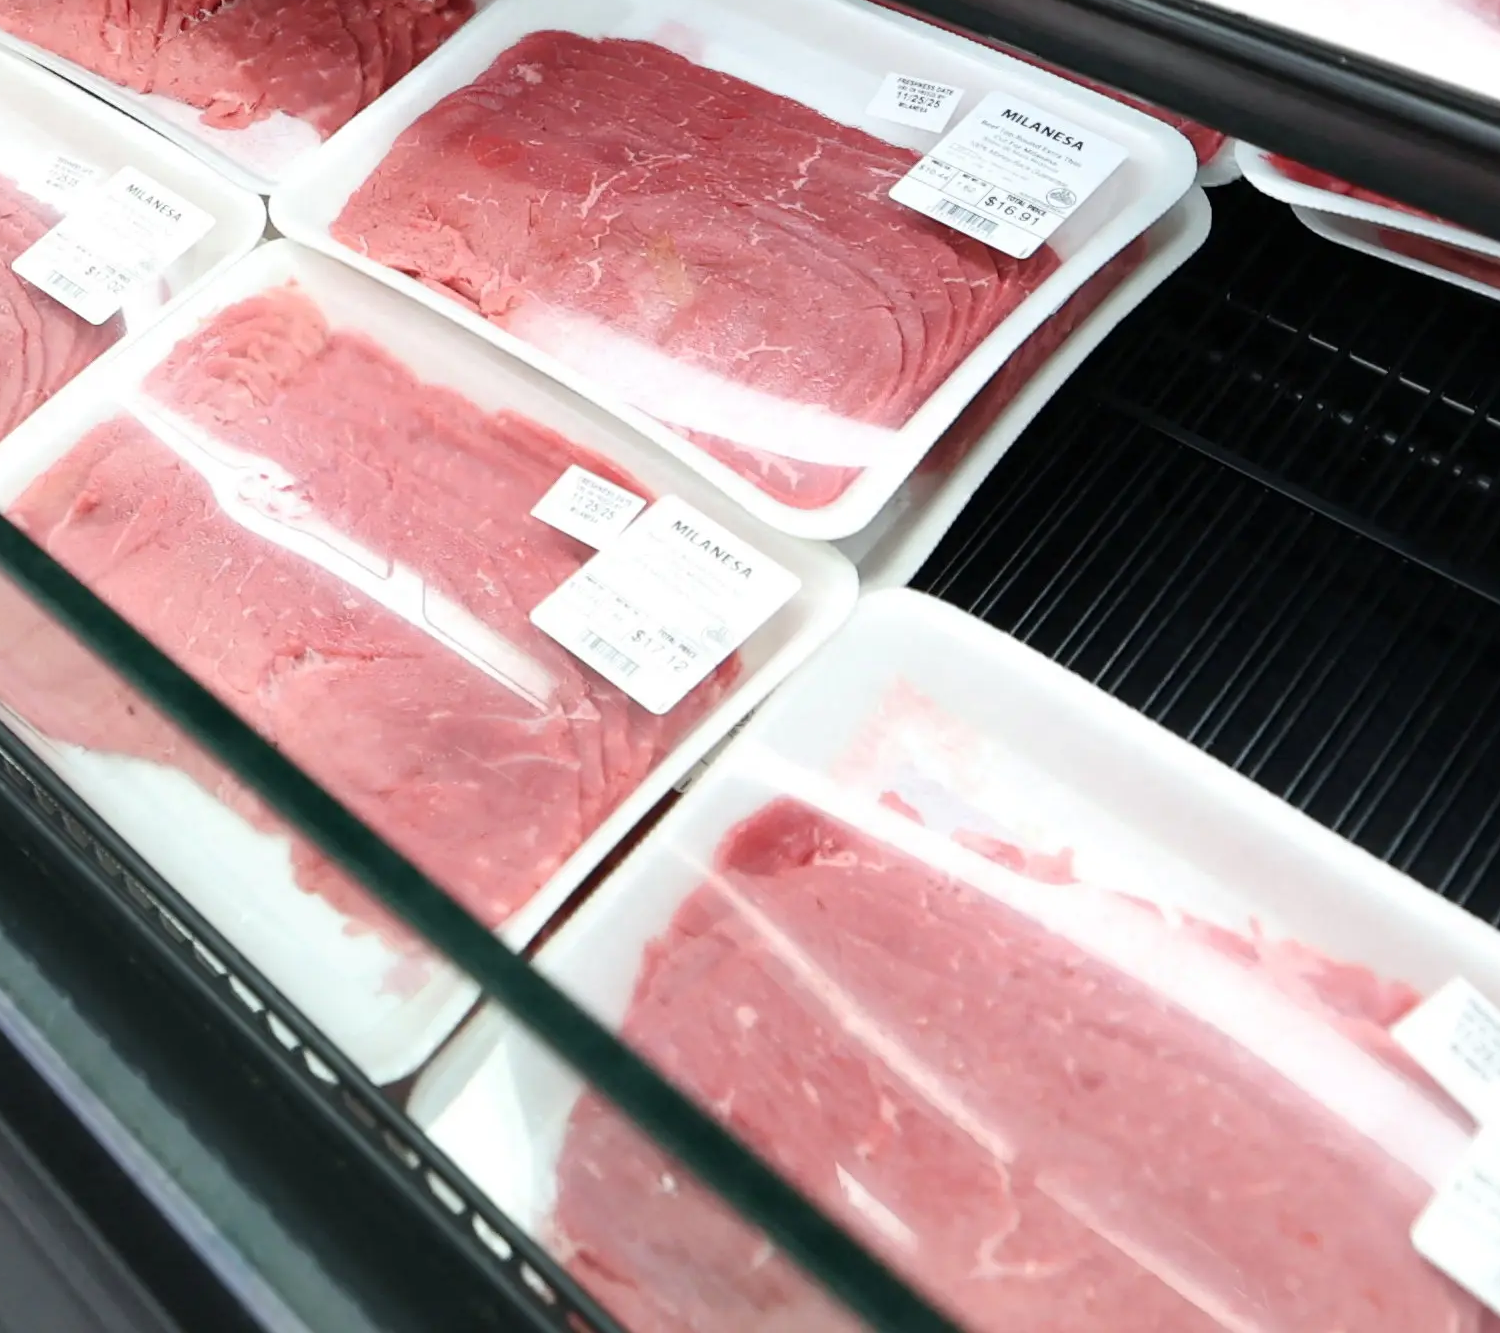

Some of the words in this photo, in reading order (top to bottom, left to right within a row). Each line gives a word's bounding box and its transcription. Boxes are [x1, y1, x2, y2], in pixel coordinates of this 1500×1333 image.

[896, 91, 941, 109] 11/25/25
[897, 77, 936, 91] FRESHNESS
[937, 86, 954, 96] DATE
[1001, 108, 1084, 151] MILANESA
[126, 183, 182, 222] MILANESA
[984, 195, 1041, 227] $16.91
[1006, 193, 1026, 208] TOTAL
[1027, 202, 1047, 217] PRICE
[671, 519, 754, 580] MILANESA
